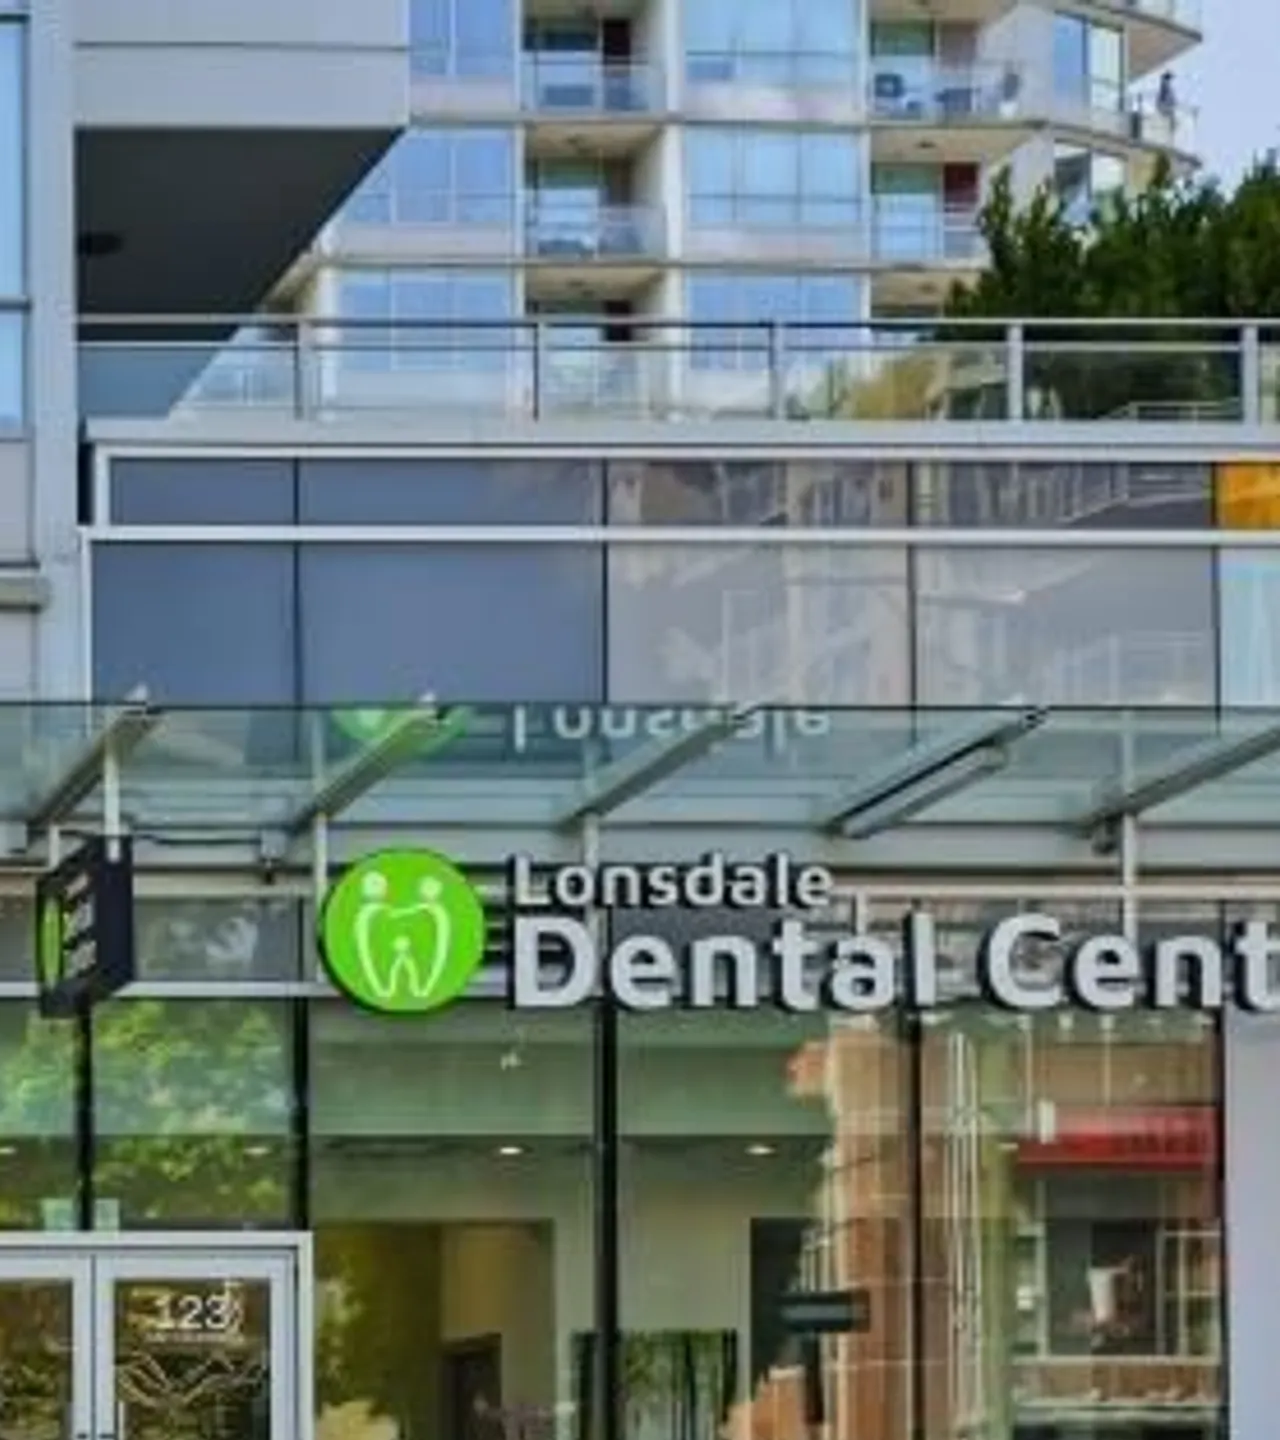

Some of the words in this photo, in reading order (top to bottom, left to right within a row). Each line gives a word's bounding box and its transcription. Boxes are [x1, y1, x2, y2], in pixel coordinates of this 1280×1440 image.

[513, 853, 833, 906] Lonsdale
[512, 912, 937, 1011] Dental
[988, 912, 1280, 1010] Cent
[153, 1294, 232, 1329] 123
